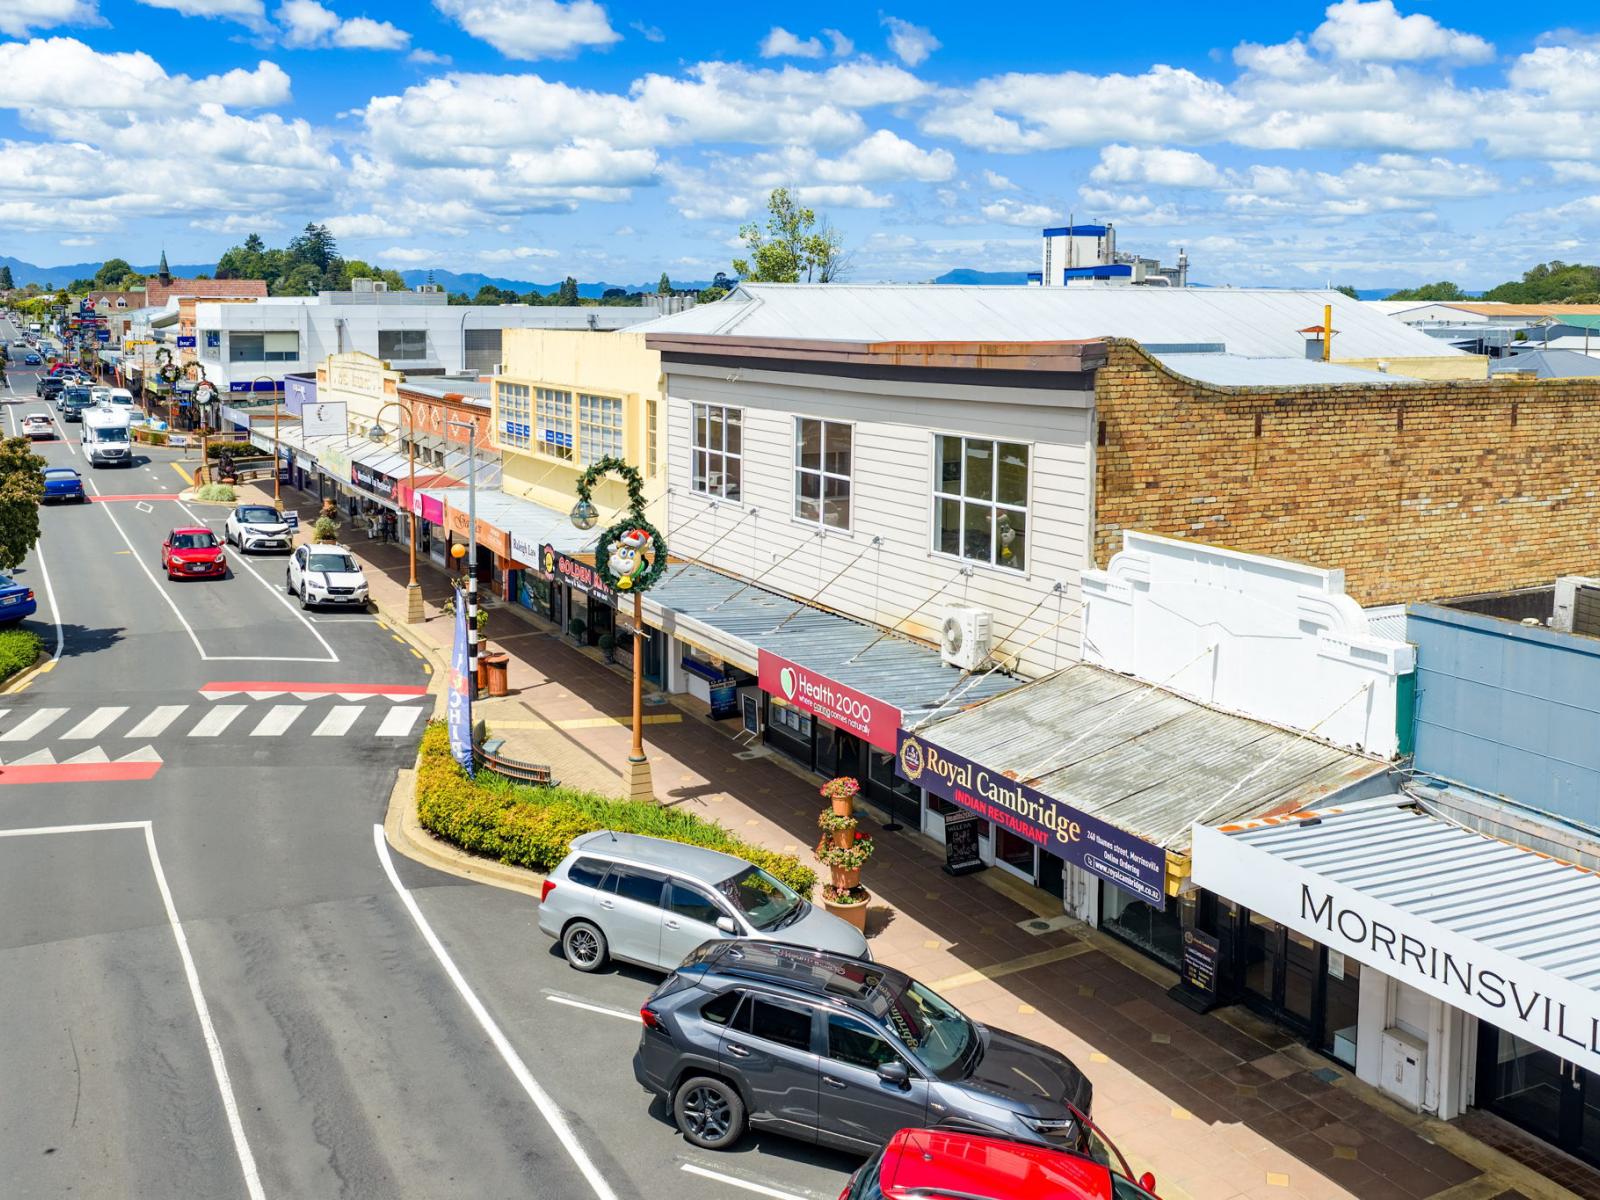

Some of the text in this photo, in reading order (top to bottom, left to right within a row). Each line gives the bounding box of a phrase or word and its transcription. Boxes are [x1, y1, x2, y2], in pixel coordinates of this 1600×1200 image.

[559, 556, 592, 585] GOLDEN
[798, 671, 871, 723] Health 2000
[798, 695, 870, 737] where caring comes naturally
[926, 747, 1081, 843] Royal Cambridge
[954, 788, 1050, 846] INDIAN RESTAURANT
[1095, 861, 1159, 899] www.royalcambridge.co.nz
[1103, 850, 1140, 878] Online Ordering
[1129, 851, 1160, 873] Morrinsville
